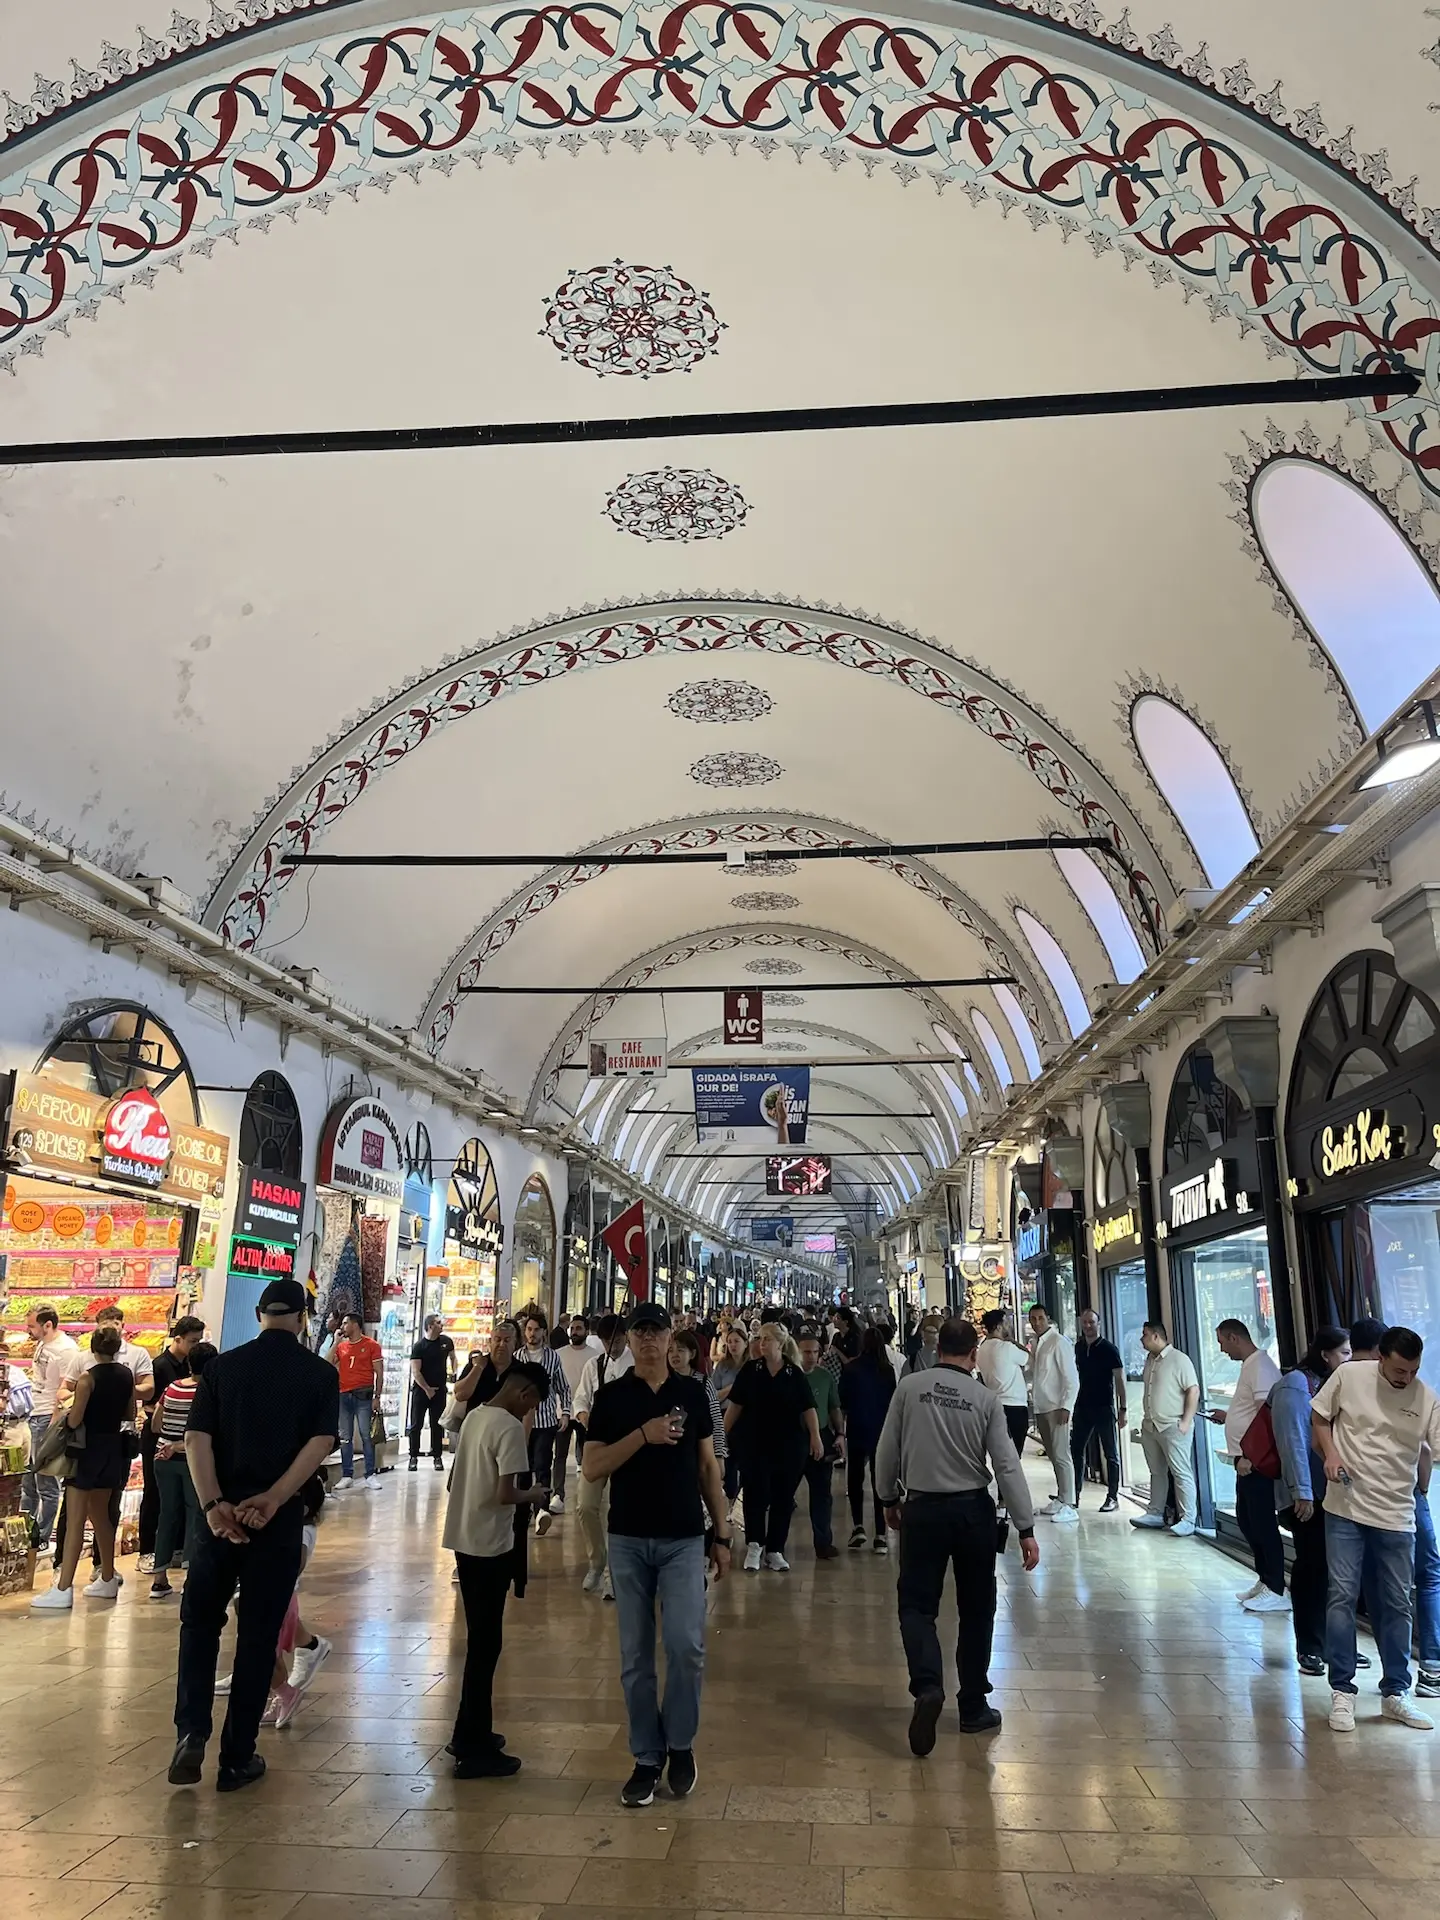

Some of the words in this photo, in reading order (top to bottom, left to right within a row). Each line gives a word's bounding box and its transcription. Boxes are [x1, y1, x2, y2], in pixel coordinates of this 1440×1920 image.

[726, 1018, 761, 1034] WC
[621, 1041, 643, 1054] CAFE
[607, 1055, 663, 1069] RESTAURANT
[696, 1073, 738, 1082] GIDADA
[739, 1071, 778, 1082] İSRAFA
[696, 1083, 719, 1092] DUR
[721, 1083, 739, 1092] DE!
[19, 1132, 33, 1148] 129
[35, 1128, 87, 1163] SPICES
[176, 1134, 206, 1160] ROSE
[206, 1144, 223, 1167] OIL
[1322, 1123, 1358, 1177] Sait
[1357, 1108, 1392, 1164] Koç
[104, 1155, 134, 1175] Turkish
[134, 1161, 163, 1184] Delight
[251, 1178, 301, 1209] HASAN
[1169, 1173, 1208, 1229] TRUVA
[1235, 1190, 1249, 1215] 98
[20, 1209, 37, 1217] ROSE
[248, 1202, 299, 1225] KUYUMCULUK
